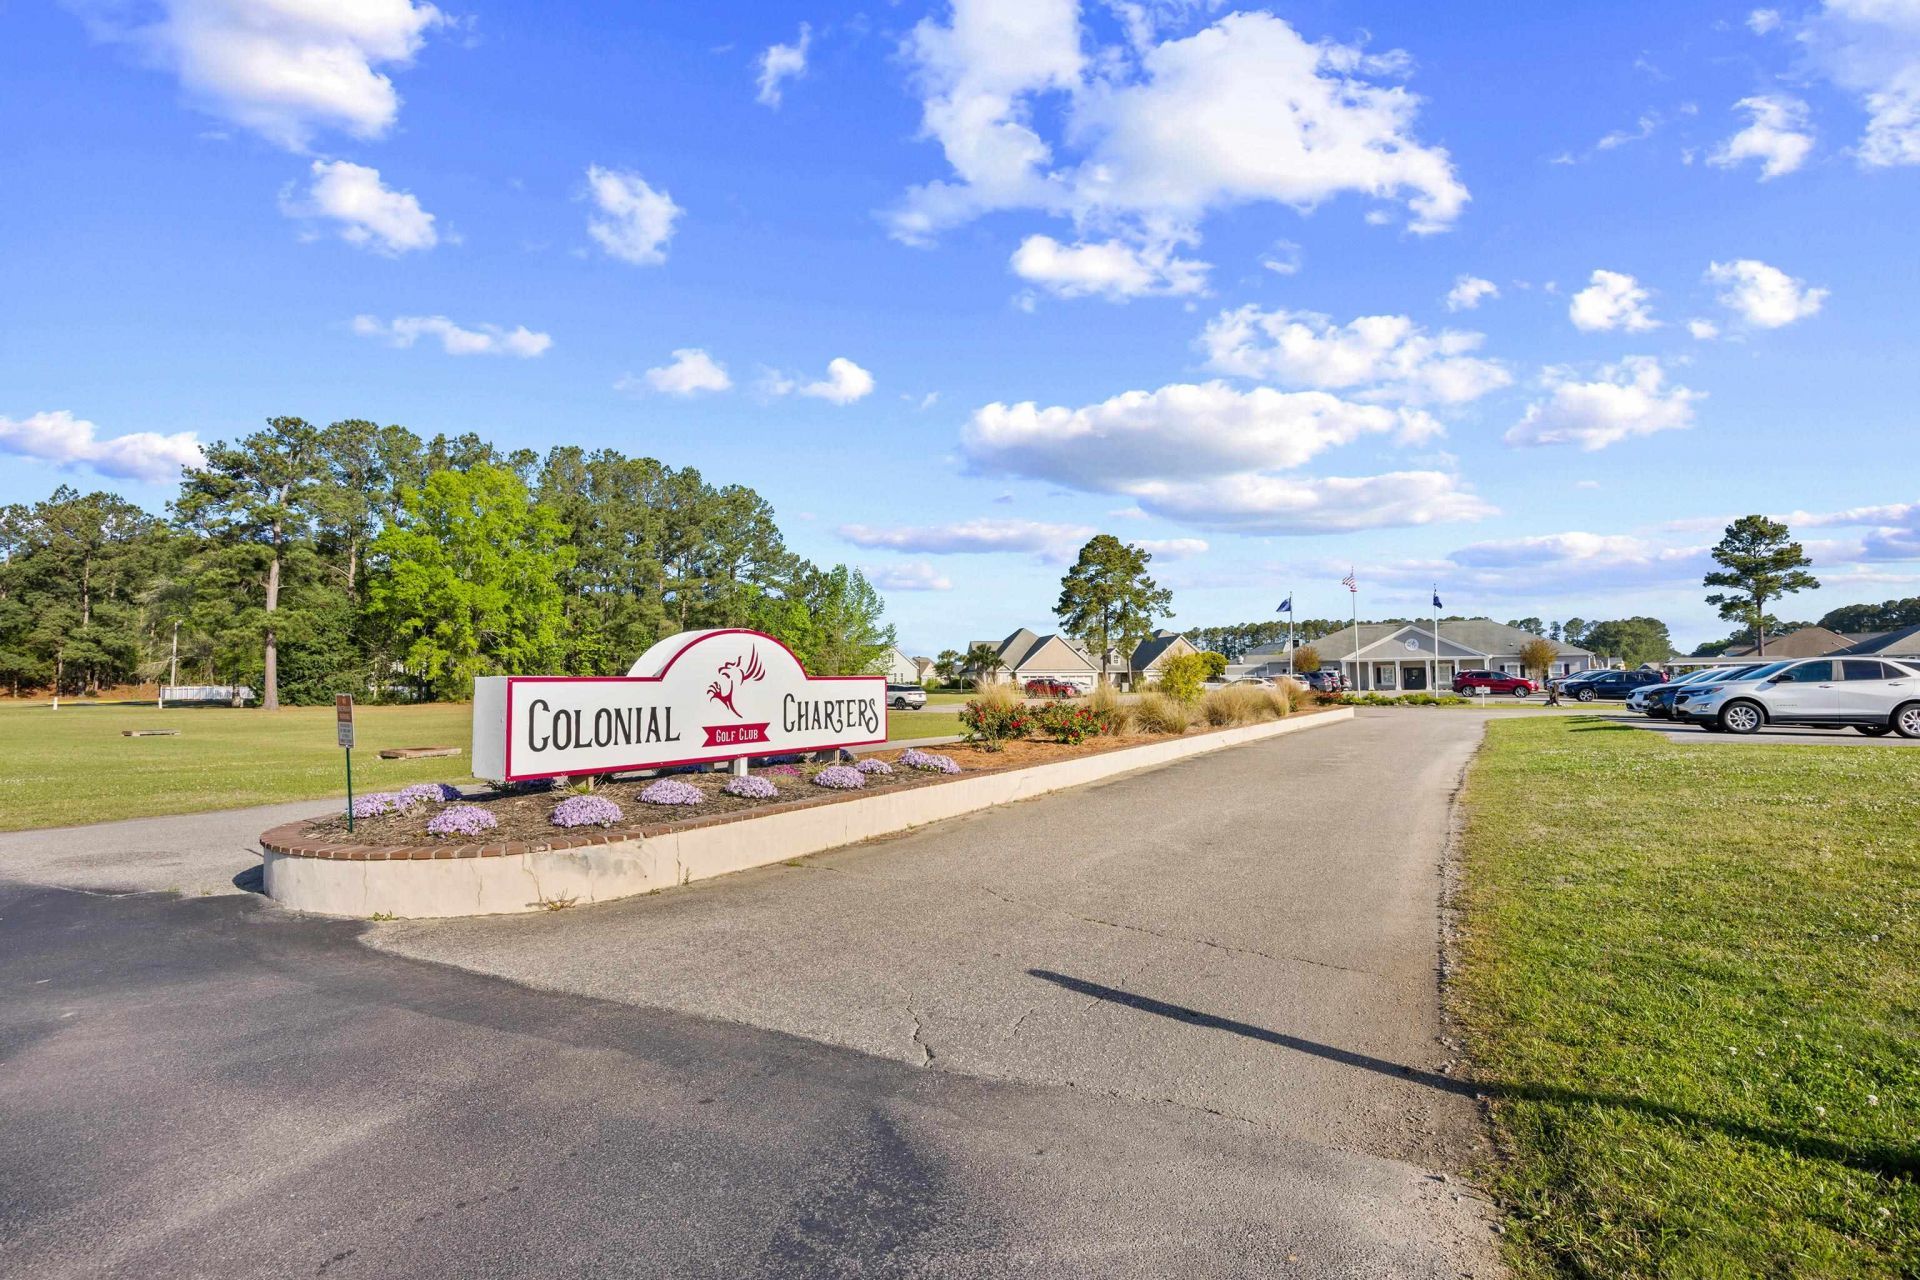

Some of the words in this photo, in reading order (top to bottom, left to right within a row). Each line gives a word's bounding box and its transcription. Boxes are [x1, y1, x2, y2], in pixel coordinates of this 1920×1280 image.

[529, 699, 681, 752] COLONIAL
[784, 693, 879, 734] CHARTERS
[716, 729, 736, 743] GOLF
[739, 727, 758, 741] CLUB
